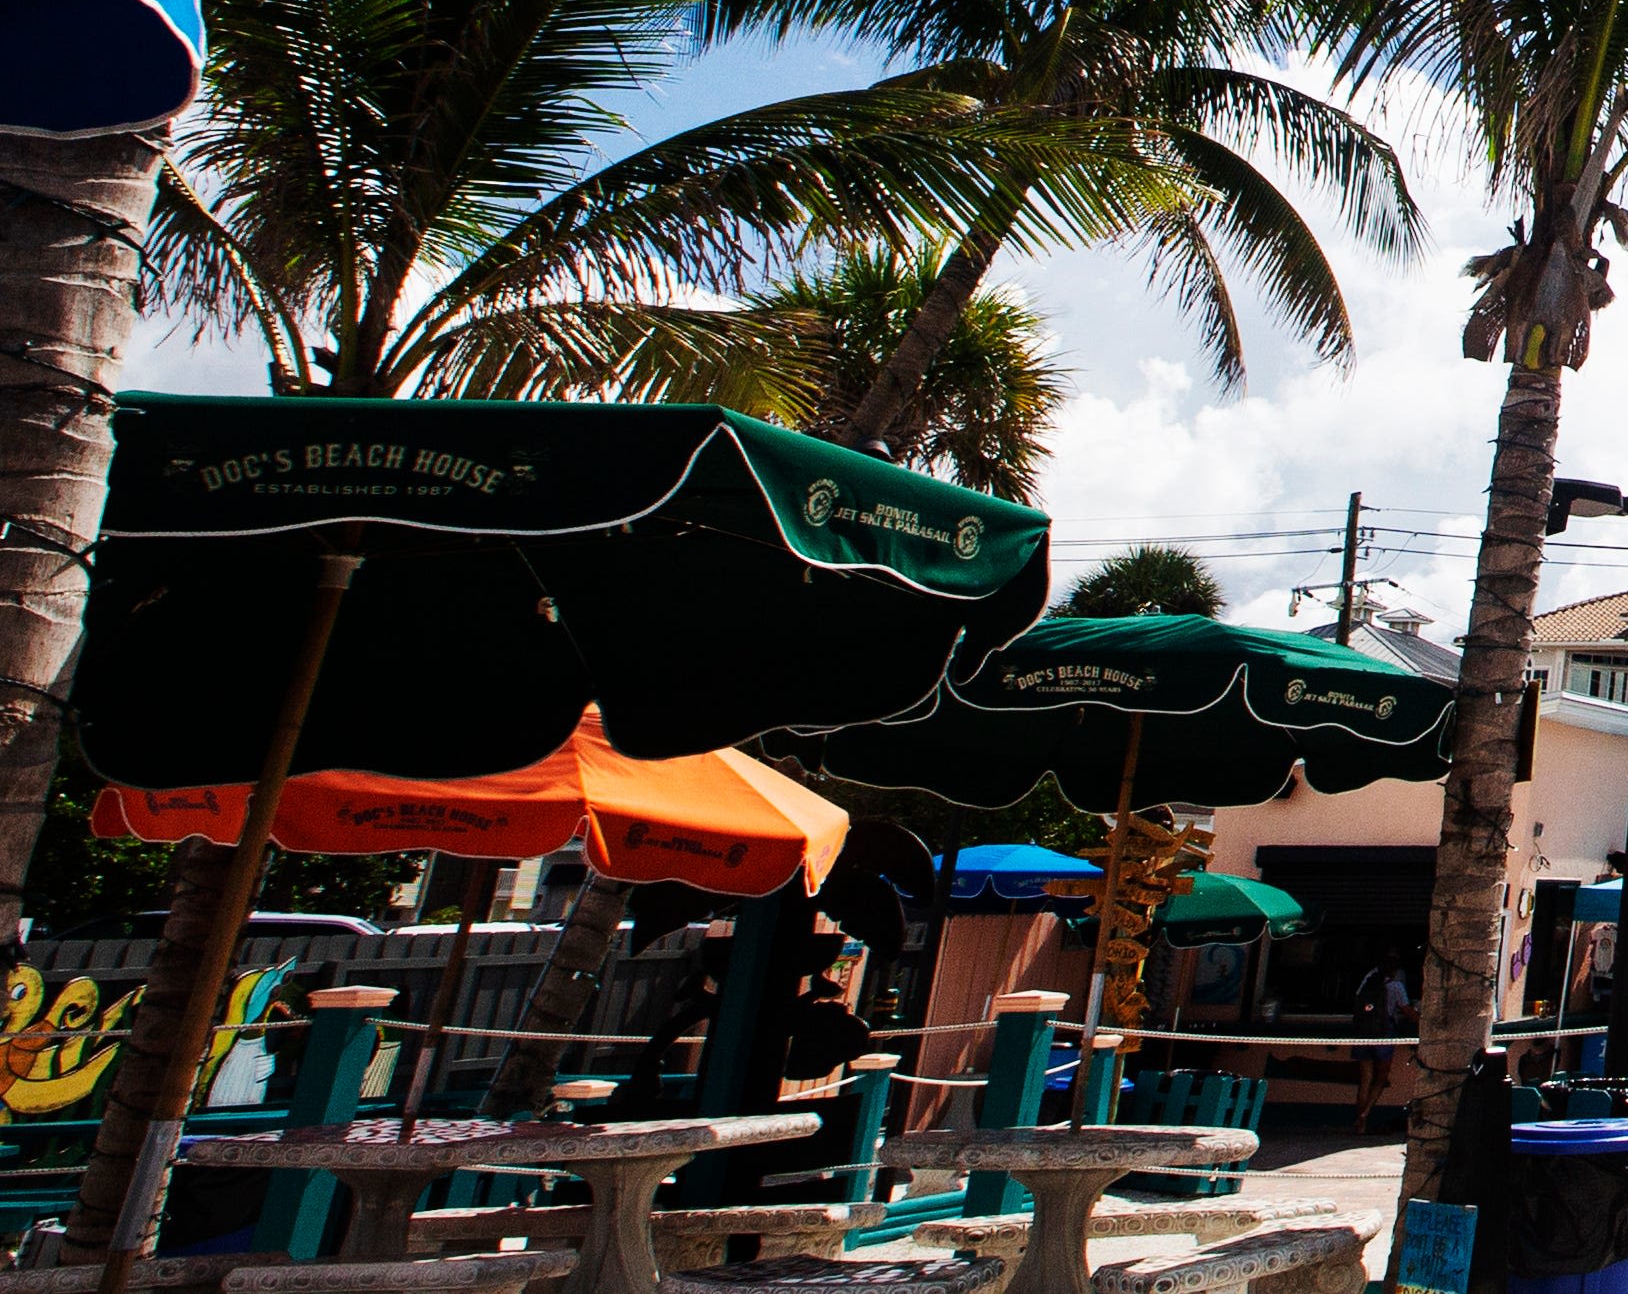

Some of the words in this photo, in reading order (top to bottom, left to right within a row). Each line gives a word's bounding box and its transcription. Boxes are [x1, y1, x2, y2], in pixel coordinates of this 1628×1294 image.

[201, 448, 293, 492] DOC'S
[303, 442, 407, 470] BEACH
[411, 448, 505, 495] HOUSE
[253, 483, 398, 496] ESTABLISHED
[405, 485, 454, 497] 1987
[833, 507, 857, 521] JET
[859, 511, 882, 527] SKI
[884, 515, 894, 529] &
[894, 519, 951, 544] PARASAIL
[874, 502, 919, 525] BONITA
[1016, 667, 1055, 690] DOC'S
[1058, 665, 1100, 679] BEACH
[1102, 667, 1144, 691] HOUSE
[1107, 946, 1136, 959] OHIO
